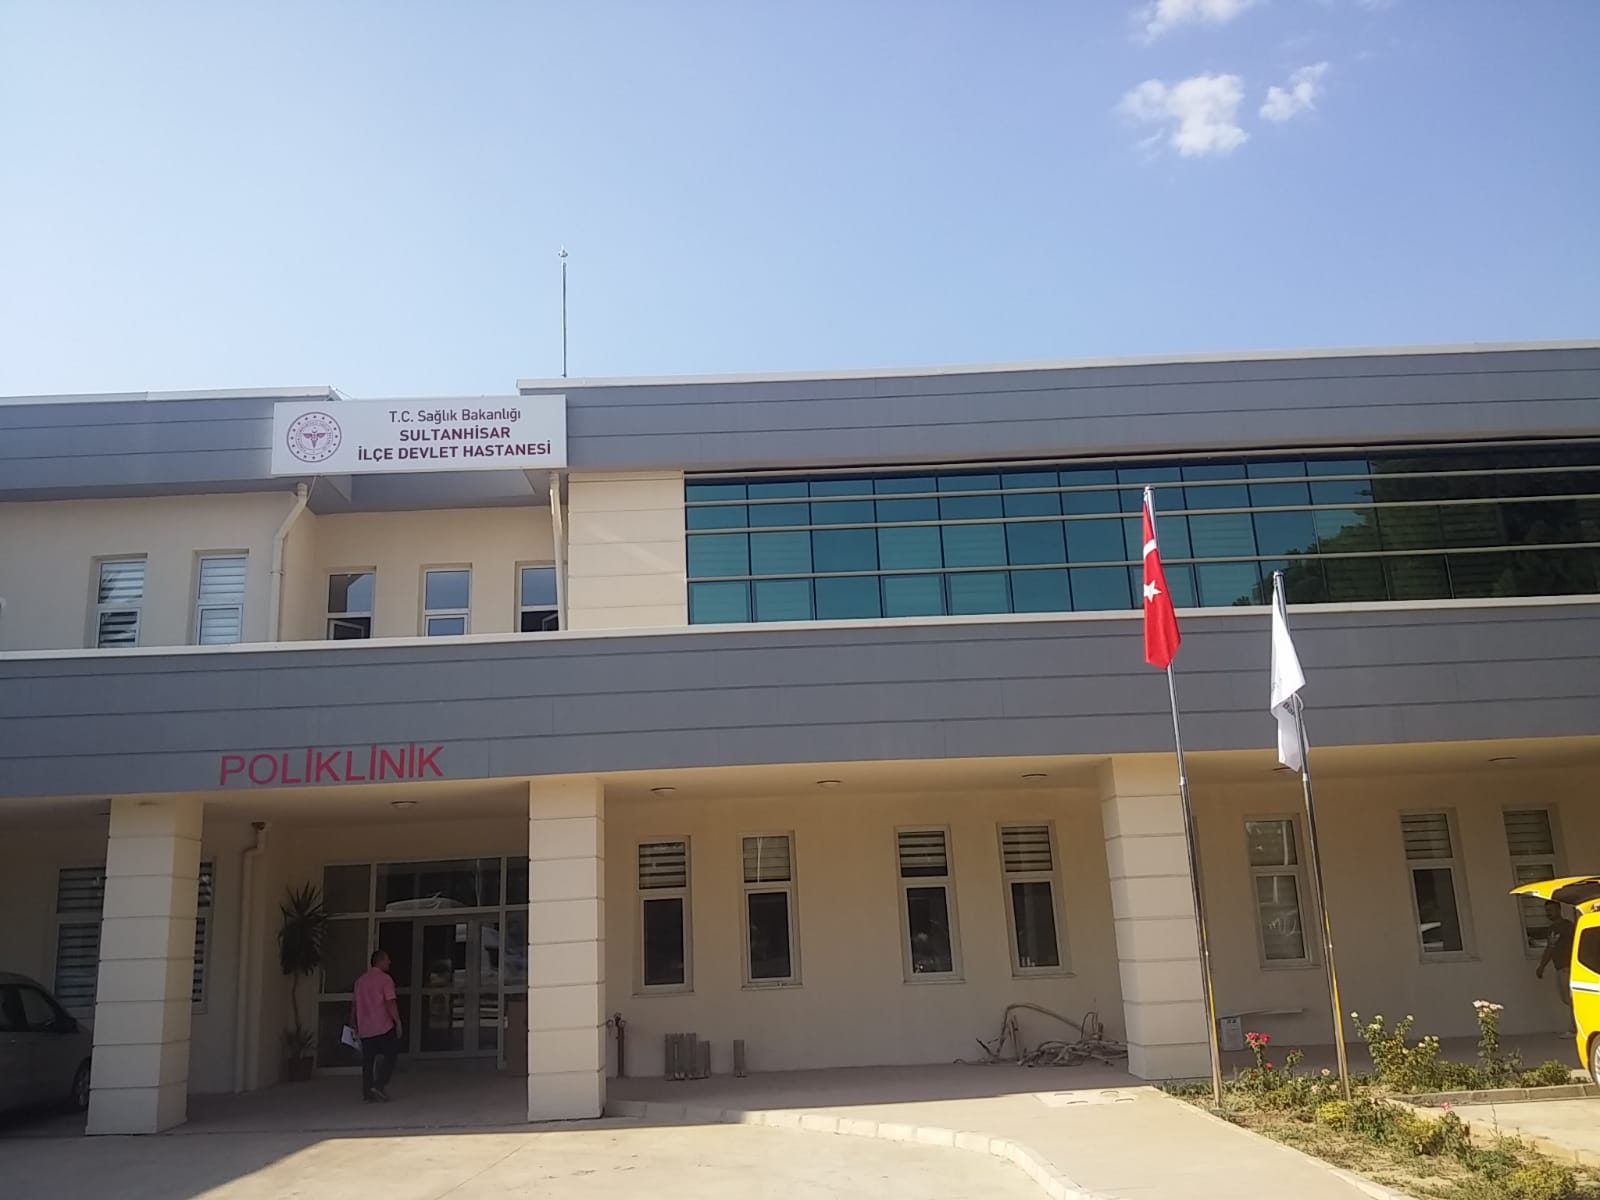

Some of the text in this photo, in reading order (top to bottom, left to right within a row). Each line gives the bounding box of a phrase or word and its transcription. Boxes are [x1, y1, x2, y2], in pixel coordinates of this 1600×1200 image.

[388, 407, 521, 425] T.C. Sağlık Bakanlığı
[399, 424, 511, 442] SULTANHİSAR
[358, 439, 551, 462] İLÇE DEVLET HASTANESİ
[219, 741, 444, 786] POLİKLİNİK
